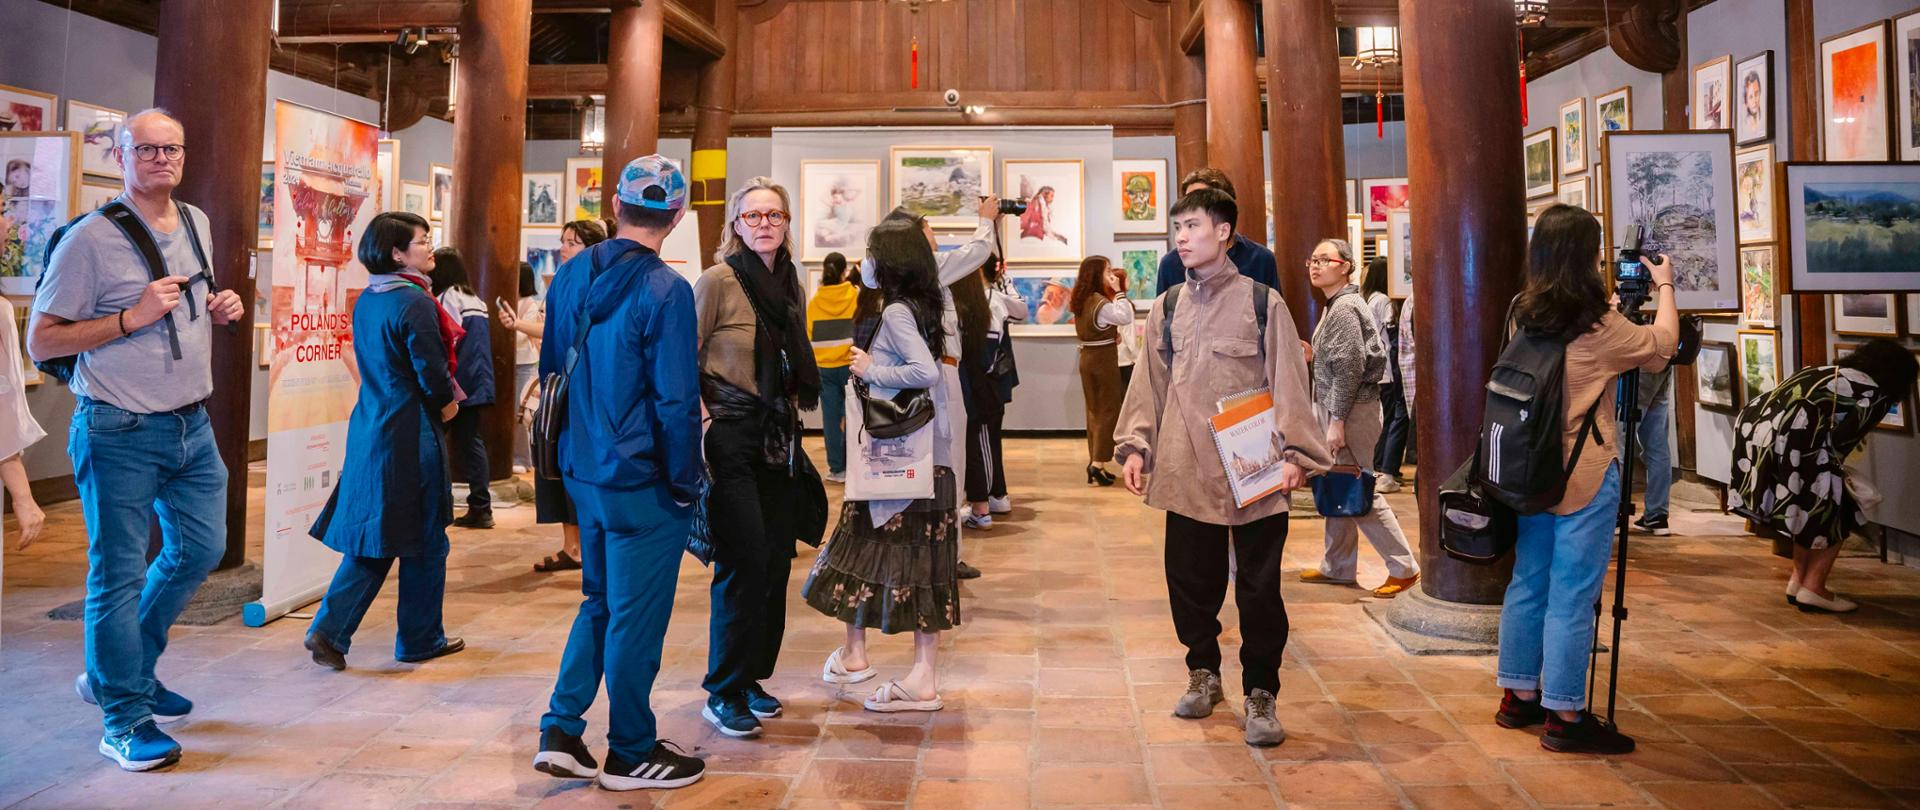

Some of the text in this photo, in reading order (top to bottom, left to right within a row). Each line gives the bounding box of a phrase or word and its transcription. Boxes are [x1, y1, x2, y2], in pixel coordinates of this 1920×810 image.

[284, 151, 326, 168] Vietnam
[283, 173, 300, 186] 2024
[291, 313, 348, 331] POLAND'S
[296, 343, 342, 362] CORNER
[1230, 424, 1249, 437] WATER
